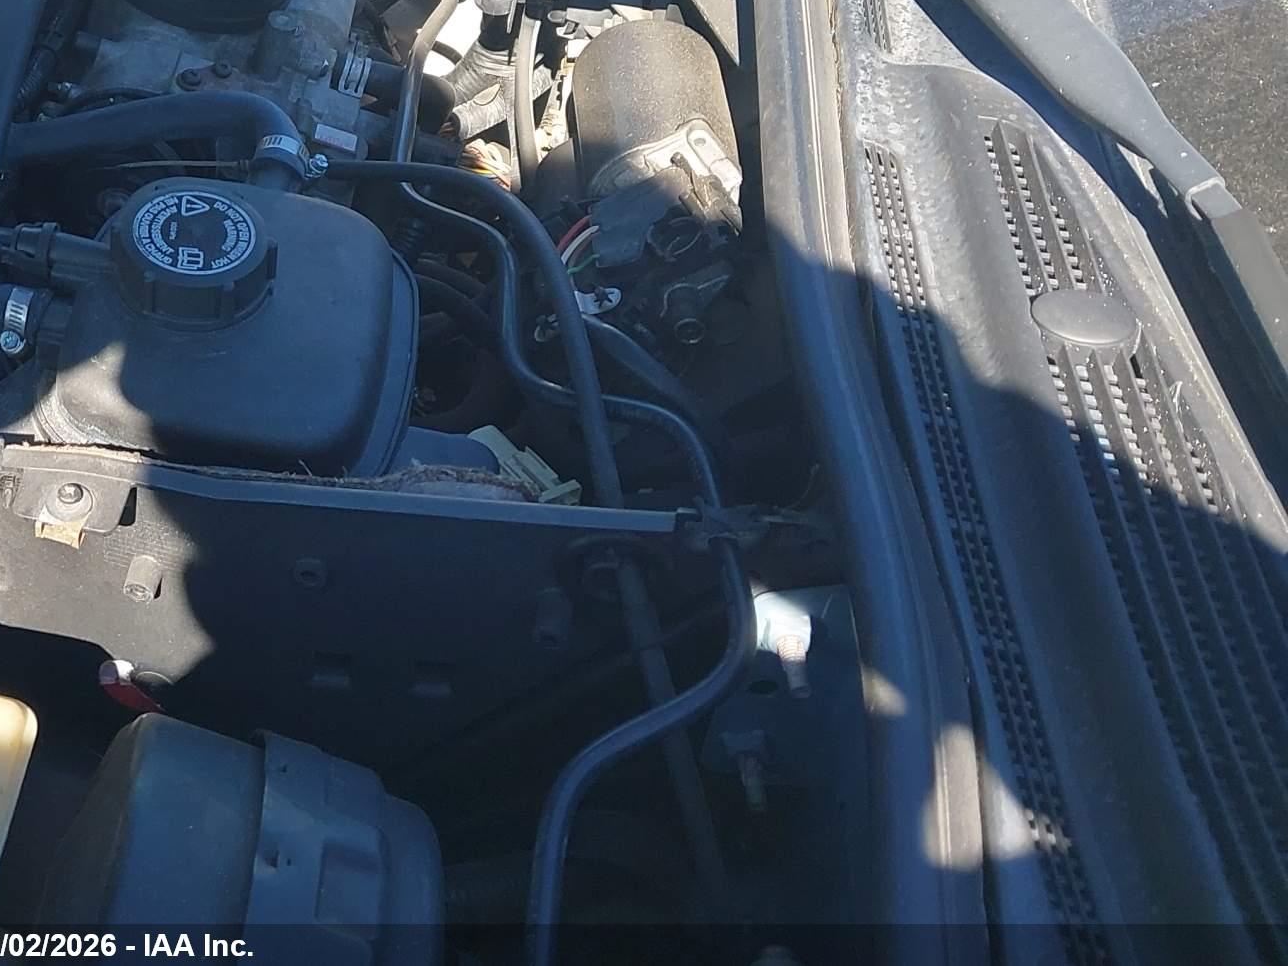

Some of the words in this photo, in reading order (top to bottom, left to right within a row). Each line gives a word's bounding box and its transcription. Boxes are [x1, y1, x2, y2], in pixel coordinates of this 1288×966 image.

[213, 201, 228, 212] DO
[225, 208, 244, 222] NOT
[221, 219, 238, 252] WARNING
[236, 222, 250, 242] OPEN
[211, 256, 231, 269] HOT
